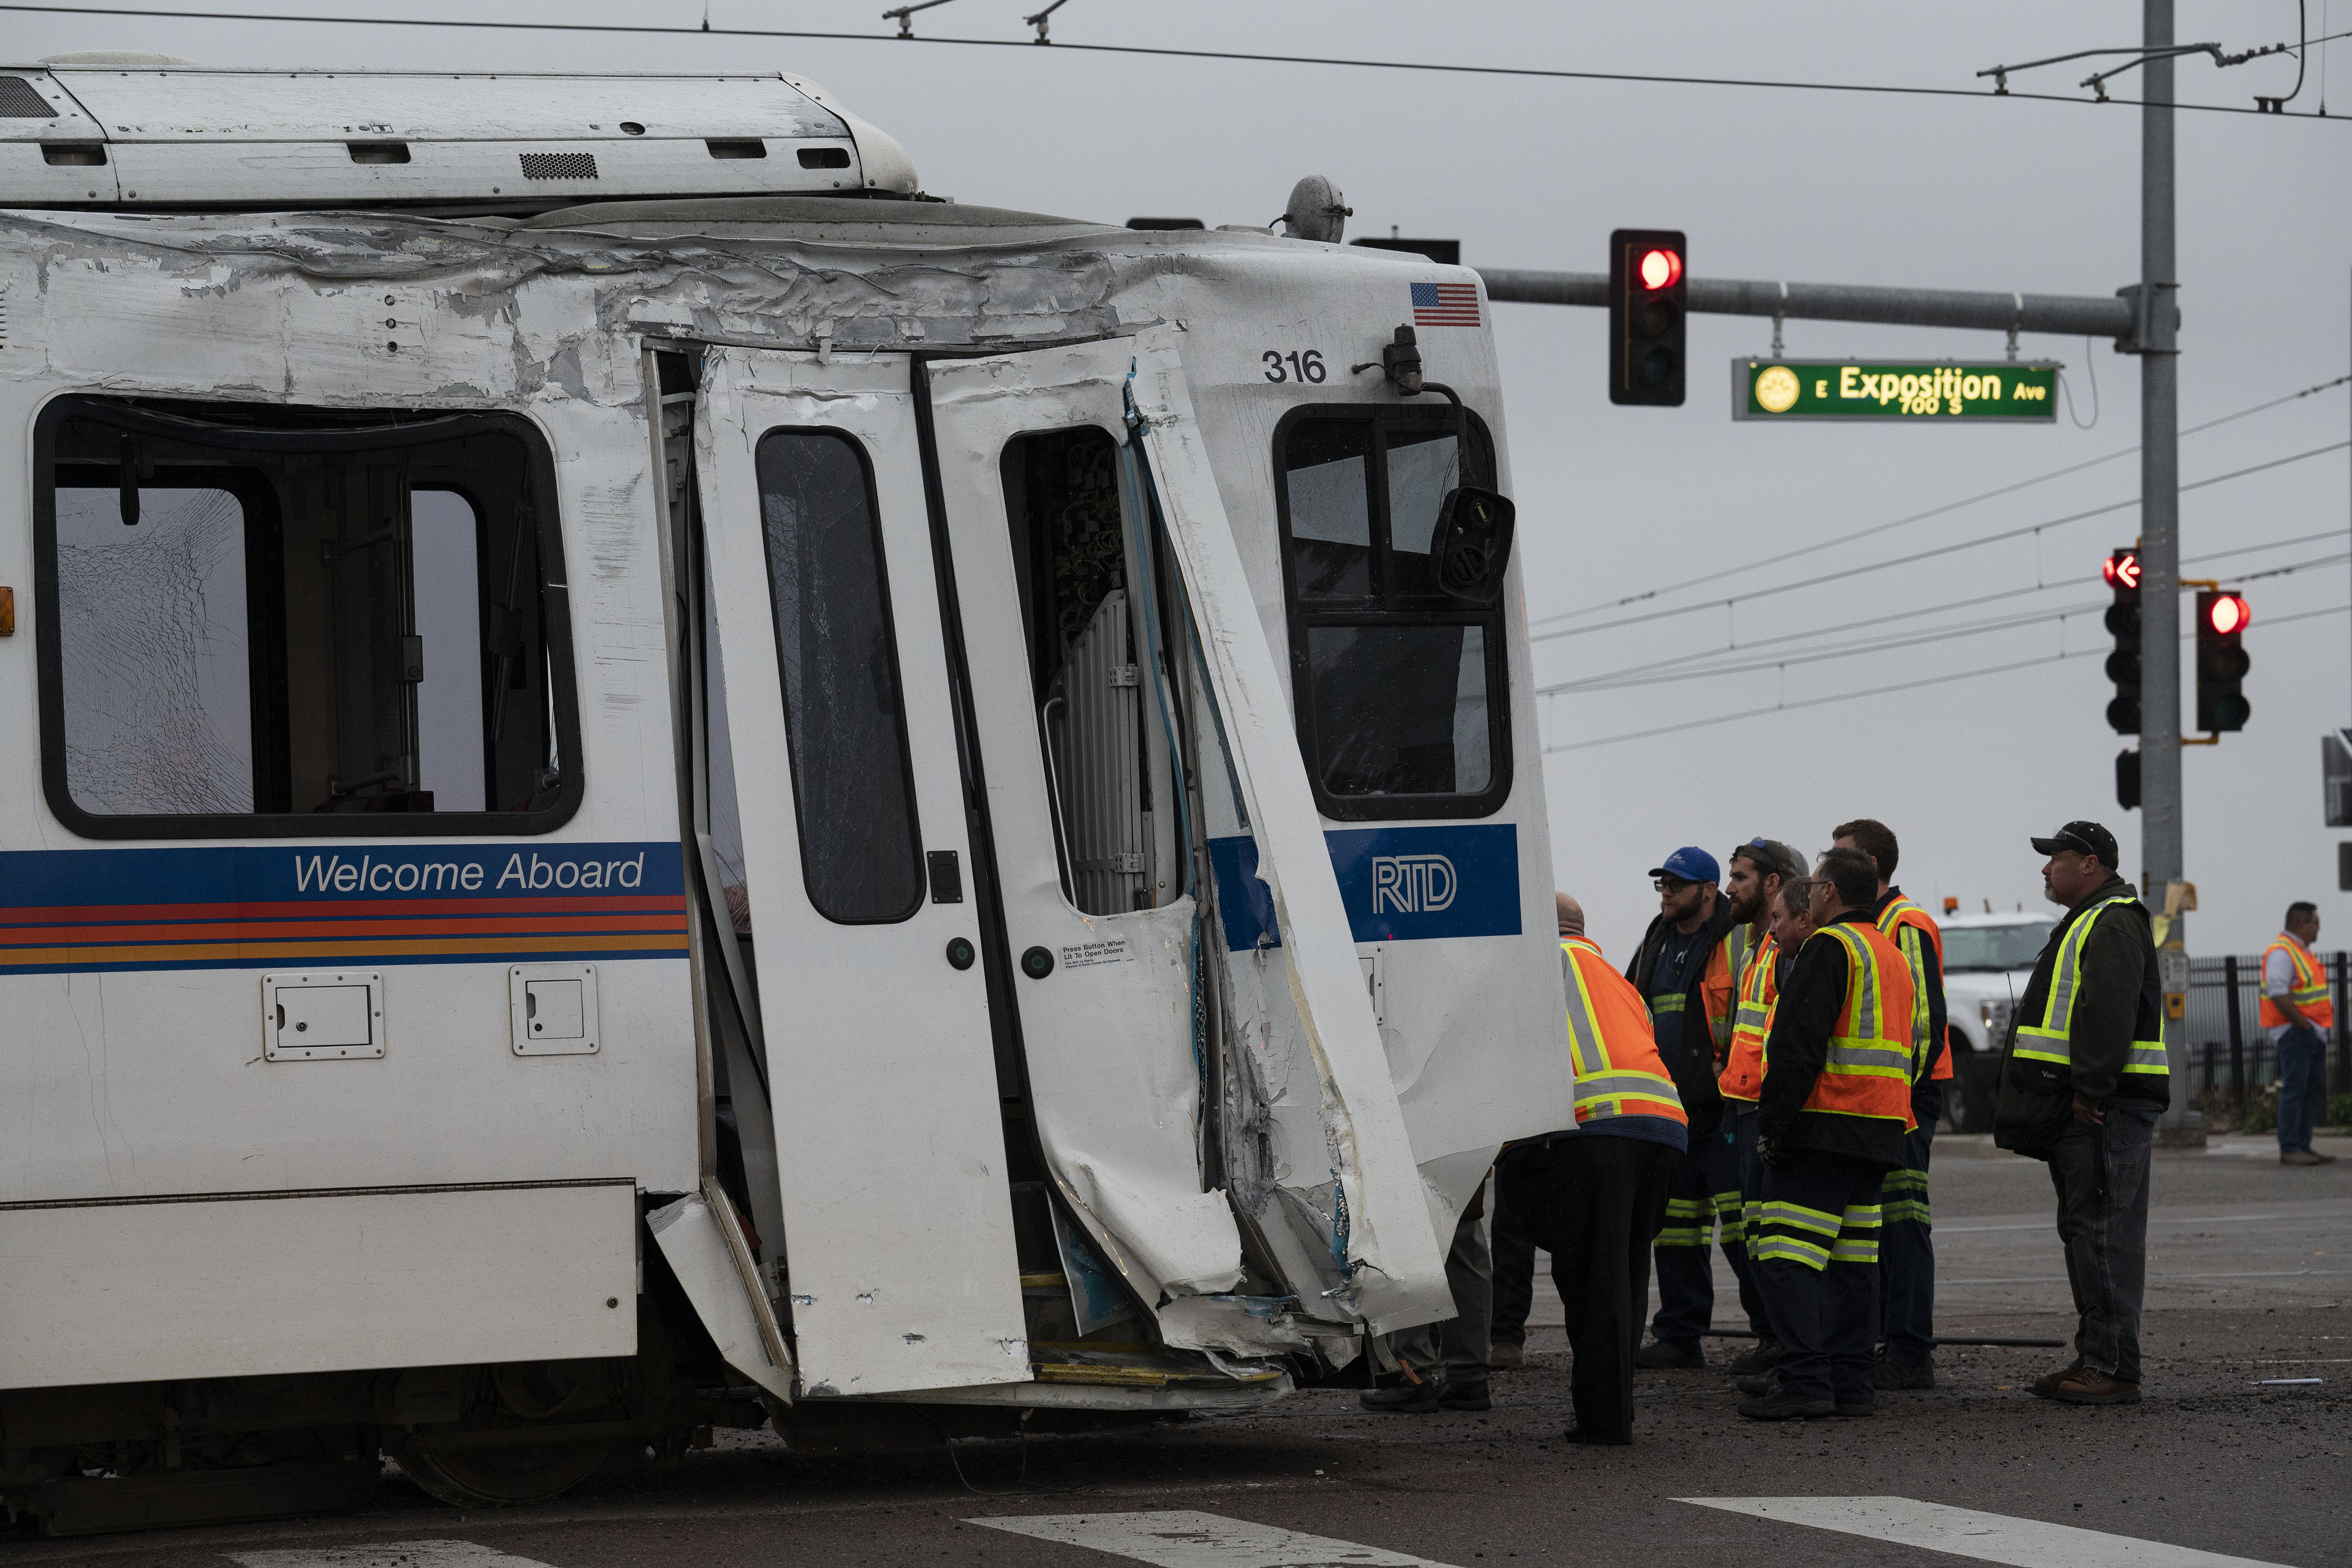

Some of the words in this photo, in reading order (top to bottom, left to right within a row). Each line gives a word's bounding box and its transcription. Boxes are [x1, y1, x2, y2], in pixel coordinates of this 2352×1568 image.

[1262, 349, 1327, 384] 316
[1815, 380, 1828, 399] E
[1840, 367, 2001, 406] Exposition
[2013, 382, 2046, 401] Ave
[1899, 396, 1940, 415] 700
[1949, 398, 1963, 416] S
[295, 855, 484, 892] Welcome
[496, 852, 645, 889] Aboard
[1372, 854, 1457, 914] RTD
